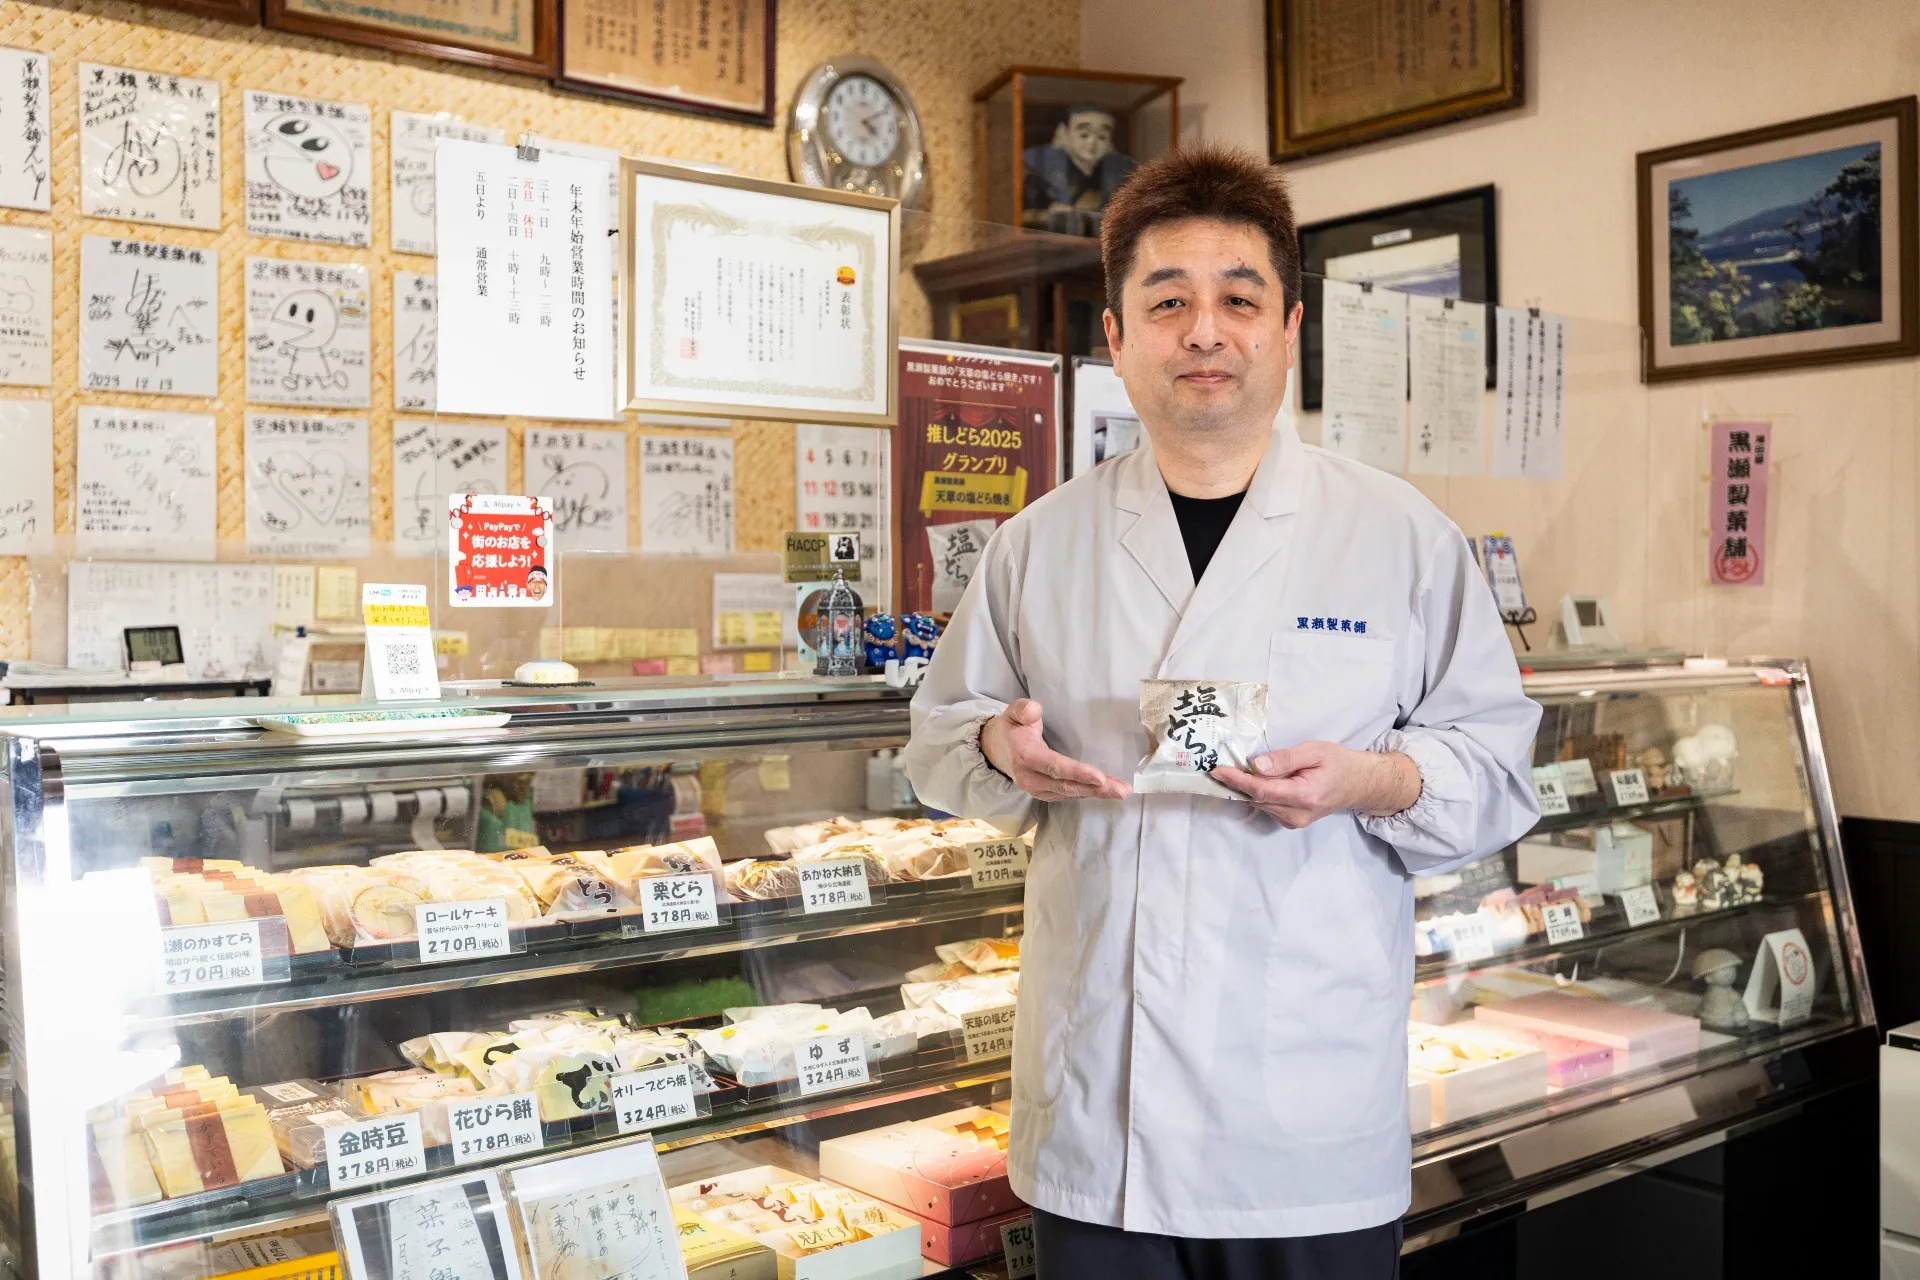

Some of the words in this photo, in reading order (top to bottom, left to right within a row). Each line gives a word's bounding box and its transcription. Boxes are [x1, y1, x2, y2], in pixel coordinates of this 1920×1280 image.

[475, 171, 486, 221] 五日より
[523, 178, 534, 203] 元旦
[539, 179, 550, 228] 三十一日
[523, 214, 534, 239] 休日
[475, 246, 489, 298] 通常営業
[569, 184, 586, 381] 年末年始営業時間のお知らせ
[840, 291, 852, 331] 表彰状
[928, 376, 1005, 392] おめでとうございます
[927, 424, 1022, 449] 推しどら2025
[943, 453, 1008, 473] グランプリ
[936, 490, 1010, 505] 天草の塩どら焼き
[484, 522, 521, 532] PayPayで
[472, 535, 531, 550] 街のお店を
[787, 539, 827, 552] HACCP
[973, 843, 1018, 859] つぶあん
[801, 864, 862, 881] あかね大納言
[652, 881, 703, 901] 栗どら
[426, 906, 497, 922] ロールケーキ
[809, 1038, 851, 1060] ゆず
[614, 1074, 687, 1098] オリーブどら焼
[453, 1099, 532, 1131] 花びら餅
[338, 1122, 408, 1157] 金時豆
